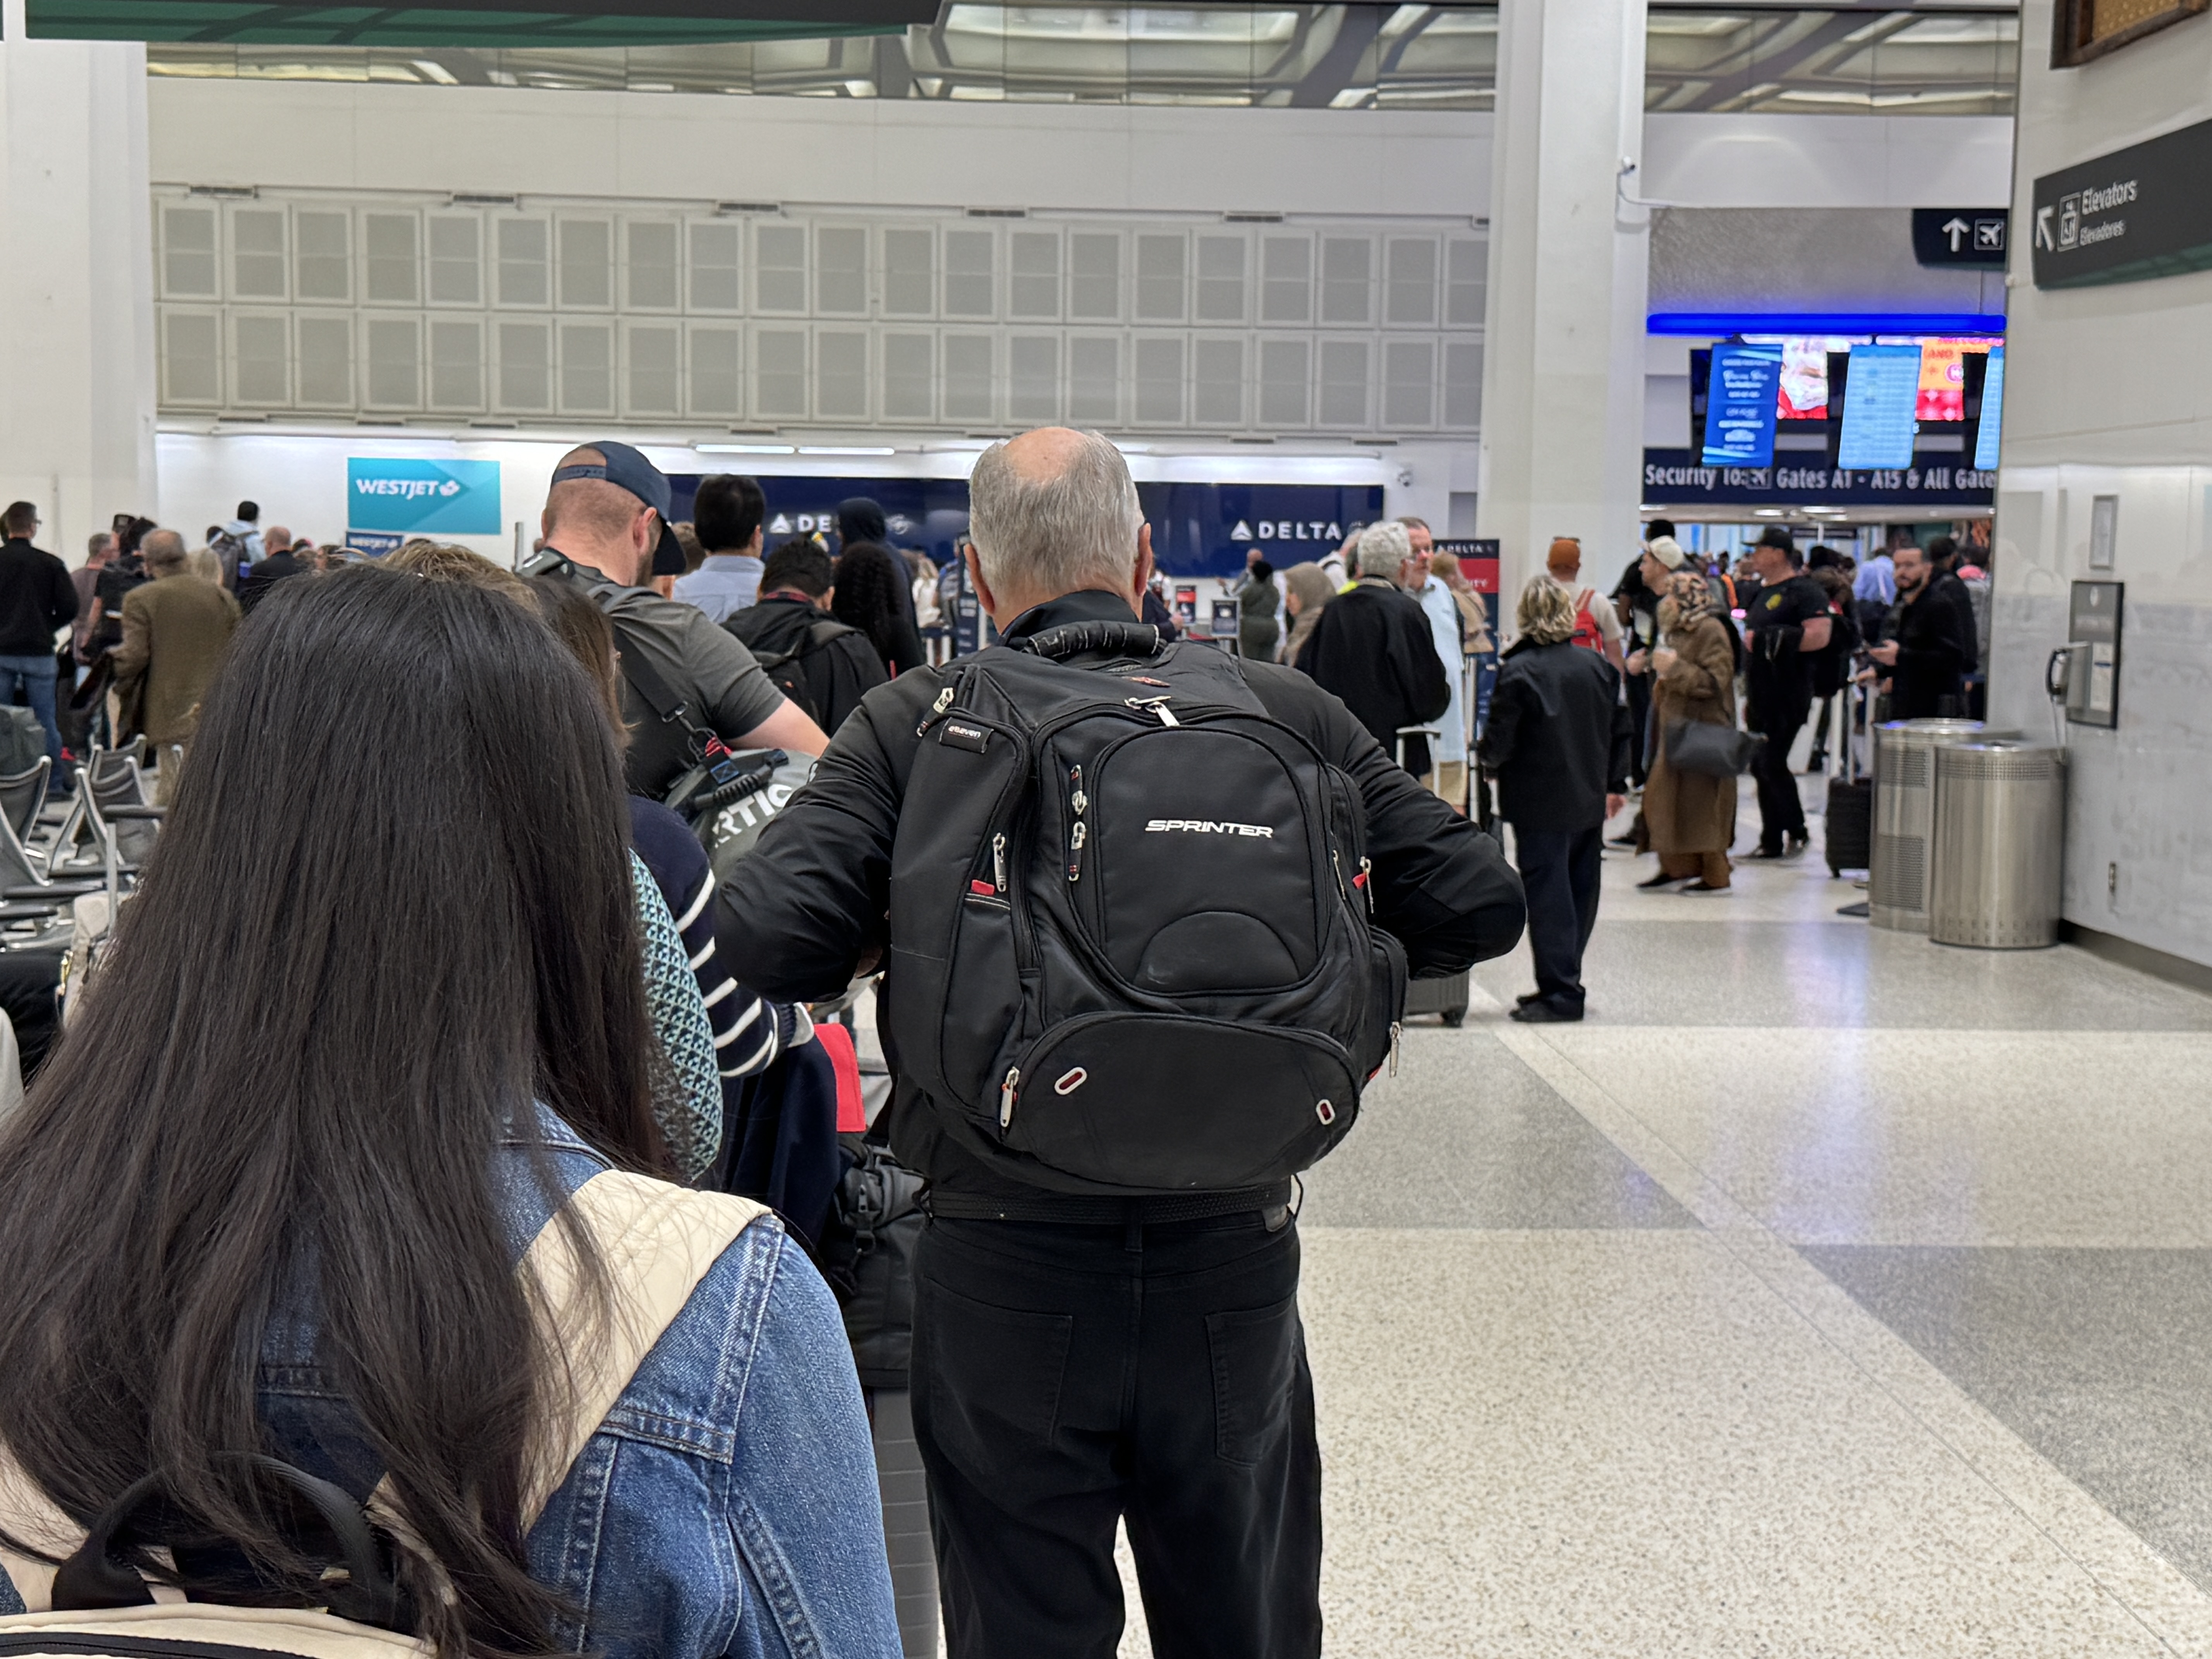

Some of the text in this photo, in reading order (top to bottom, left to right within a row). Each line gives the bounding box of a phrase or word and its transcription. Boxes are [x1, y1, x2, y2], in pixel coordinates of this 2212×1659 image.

[2082, 180, 2138, 215] Elevators
[1645, 464, 1717, 491] Security
[1776, 467, 1827, 489] Gates
[1832, 469, 1852, 489] A1
[1870, 469, 1902, 489] A15
[1906, 468, 1920, 489] &
[1923, 467, 1950, 489] All
[356, 479, 439, 500] WESTJET
[1258, 521, 1342, 540] DELTA
[1447, 543, 1483, 553] DELTA
[1145, 819, 1274, 838] SPRINTER
